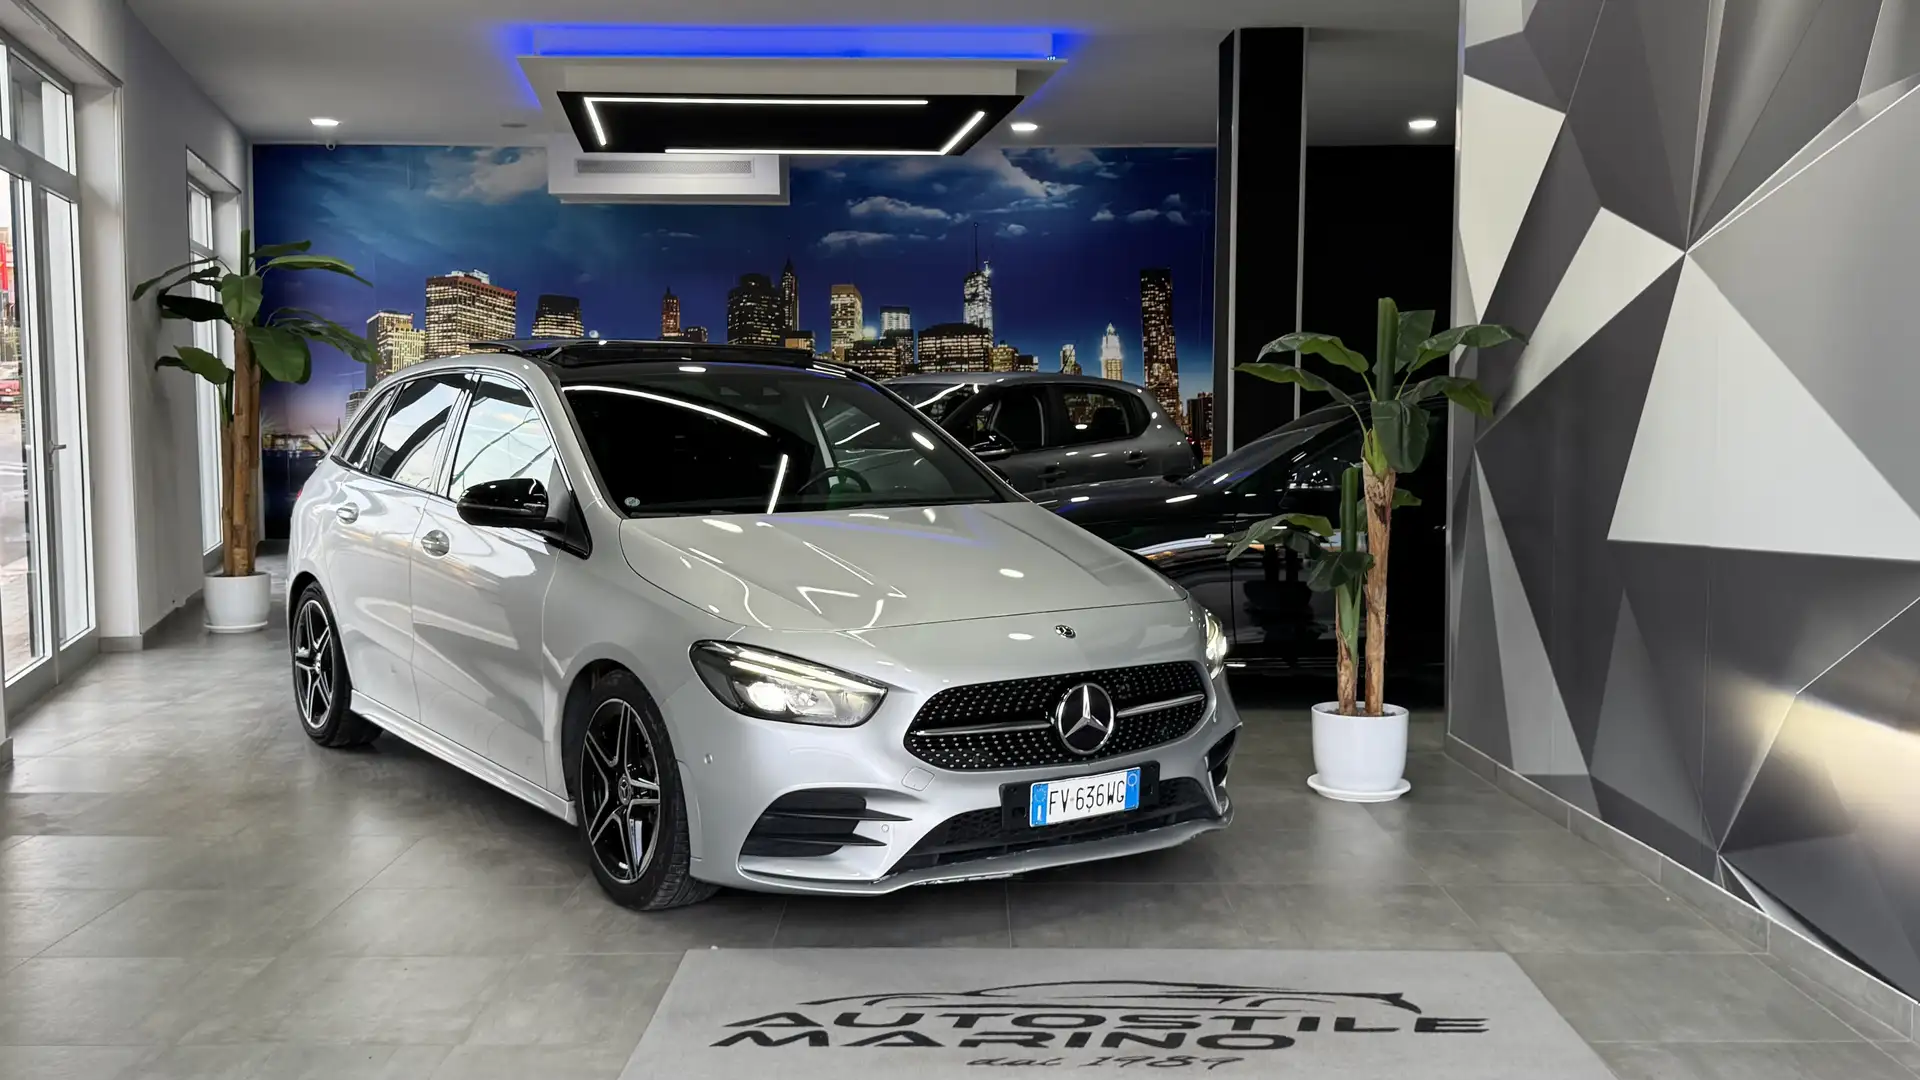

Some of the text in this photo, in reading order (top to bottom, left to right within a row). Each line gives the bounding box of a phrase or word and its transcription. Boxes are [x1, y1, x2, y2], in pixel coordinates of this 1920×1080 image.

[723, 1011, 1490, 1033] AUTOSTILE
[709, 1030, 1296, 1050] MARINO
[1077, 1055, 1245, 1070] 1989
